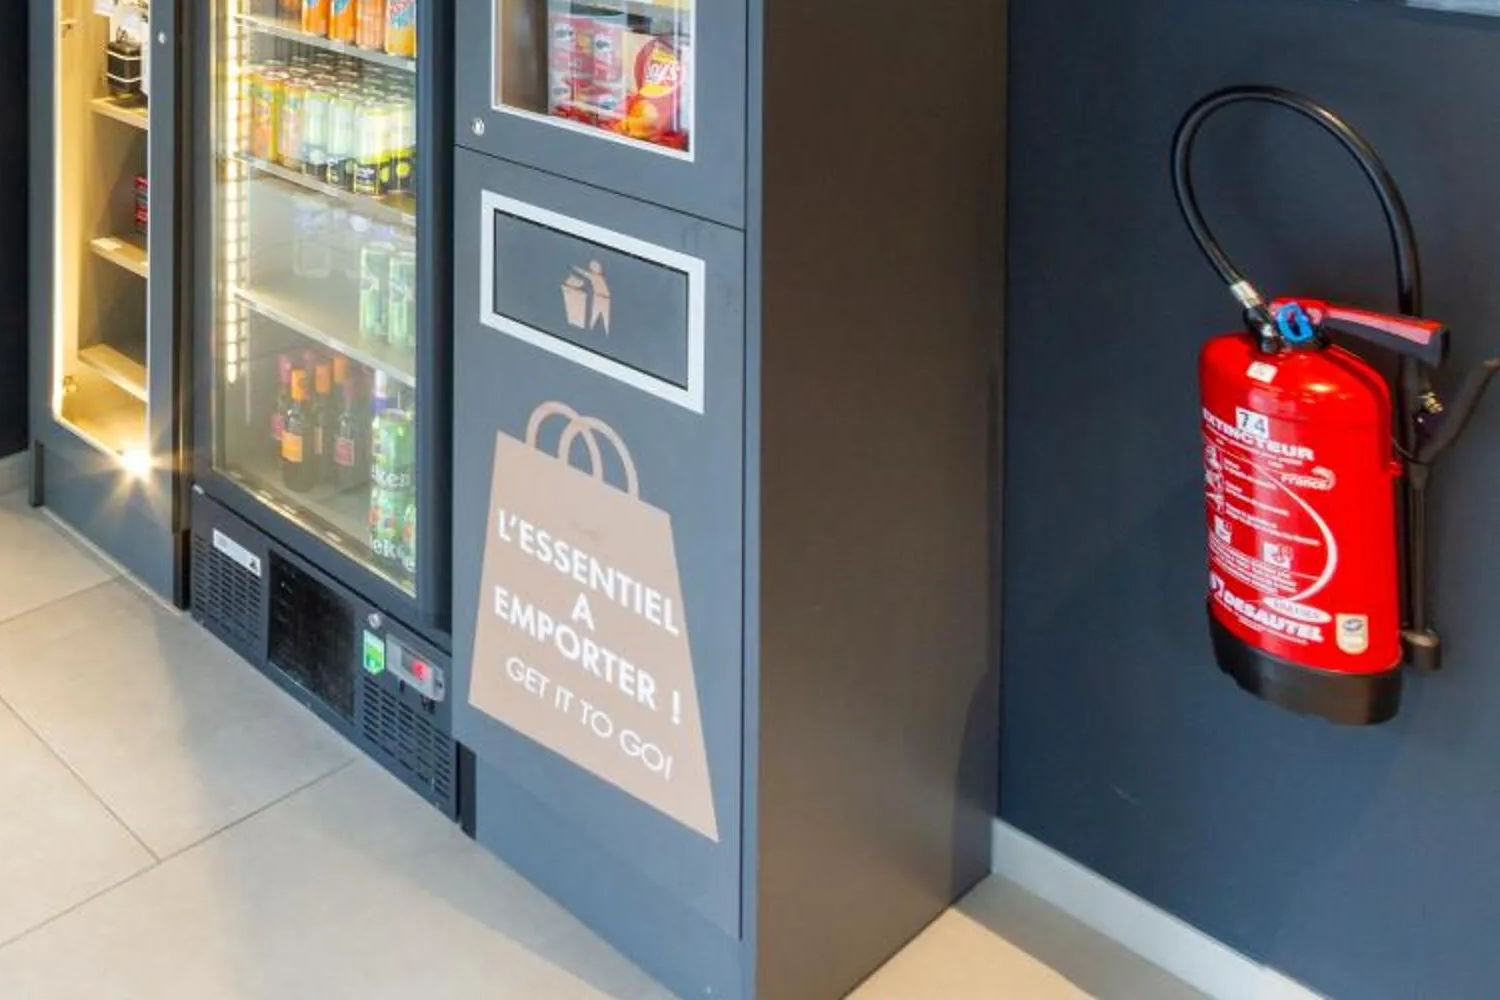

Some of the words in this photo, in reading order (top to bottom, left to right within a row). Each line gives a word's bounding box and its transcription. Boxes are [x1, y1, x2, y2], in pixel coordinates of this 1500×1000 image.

[497, 507, 680, 636] L'ESSENTIEL
[571, 592, 595, 631] A
[493, 584, 658, 711] EMPORTER
[505, 655, 550, 700] GET
[554, 683, 575, 714] IT
[578, 697, 614, 740] TO
[618, 728, 675, 782] GO!
